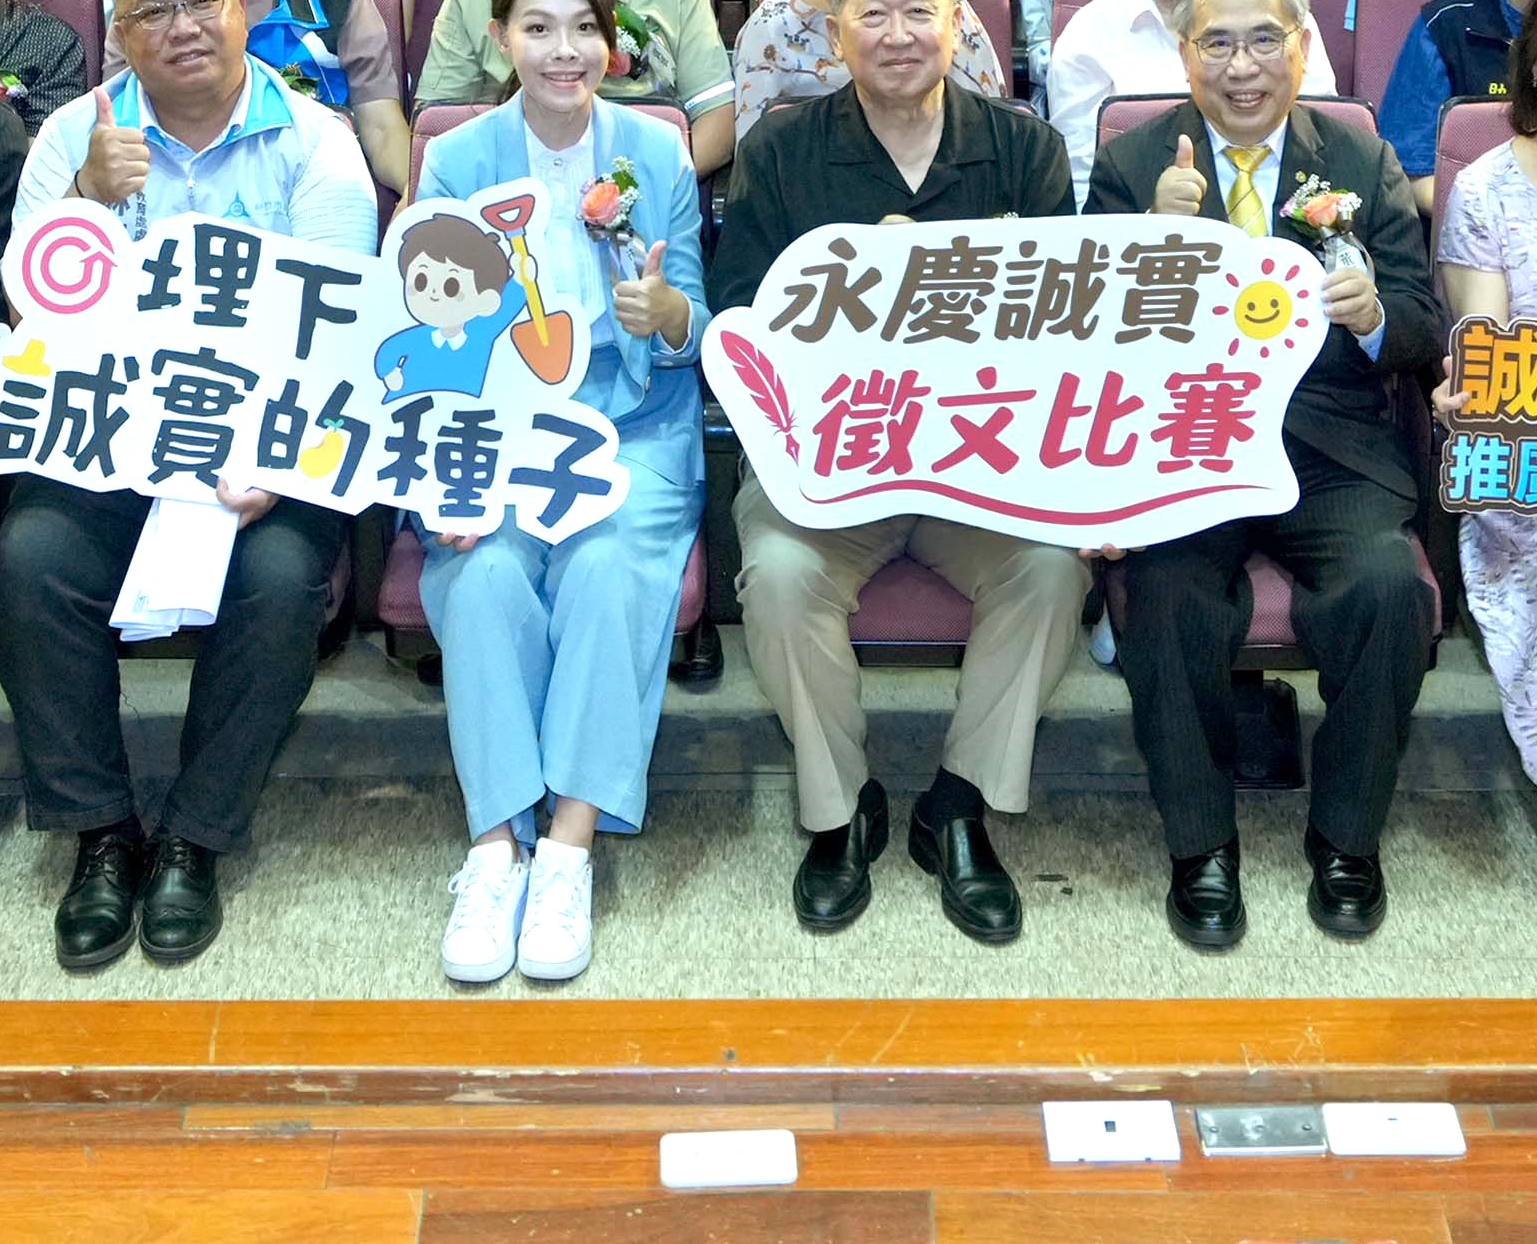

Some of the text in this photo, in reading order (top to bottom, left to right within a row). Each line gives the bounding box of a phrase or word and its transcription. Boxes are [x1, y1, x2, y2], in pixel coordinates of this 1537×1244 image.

[137, 222, 363, 360] 埋下
[767, 233, 1223, 345] 永慶誠實
[811, 363, 1263, 478] 徵文比賽
